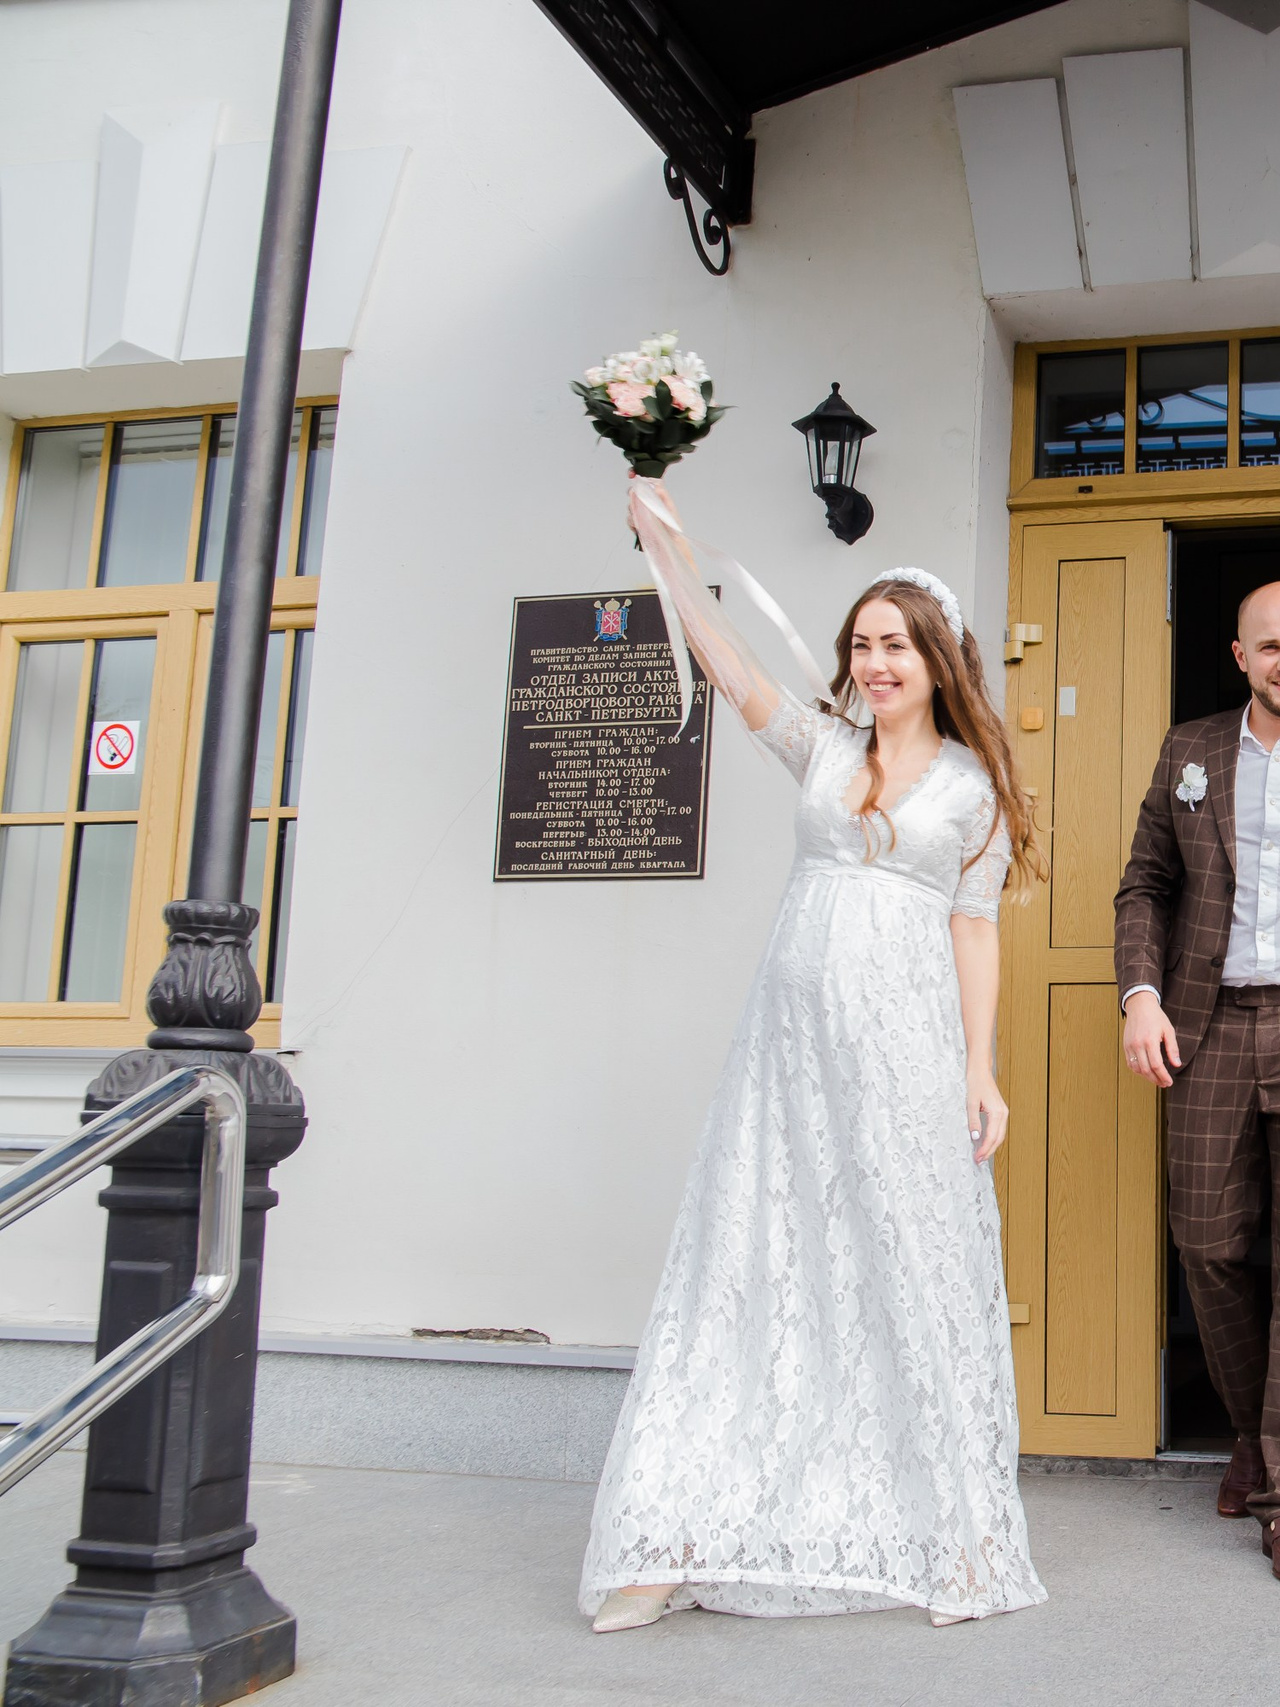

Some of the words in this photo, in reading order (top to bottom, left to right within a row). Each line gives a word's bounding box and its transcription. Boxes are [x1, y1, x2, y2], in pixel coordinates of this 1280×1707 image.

[531, 646, 598, 655] ПРАВИТЕЛЬСТВО
[533, 655, 570, 663] КОМИТЕТ
[588, 653, 619, 661] ДЕЛАМ
[623, 652, 657, 660] ЗАПИСИ
[548, 662, 615, 672] ГРАЖДАНСКОГО
[620, 660, 671, 668] СОСТОЯНИЯ
[531, 674, 576, 687] ОТДЕЛ
[583, 672, 637, 683] ЗАПИСИ
[644, 670, 679, 681] АКТО
[512, 684, 617, 699] ГРАЖДАНСКОГО
[623, 681, 706, 693] СОСТОЯЯ
[512, 697, 644, 711] ПЕТРОДВОРЦОВОГО
[649, 693, 703, 705] РАЙОА
[554, 729, 592, 739] ПРИЕМ
[598, 727, 659, 738] ГРАЖДАН:
[551, 749, 589, 757] СУББОТА
[556, 759, 591, 769] ПРИЕМ
[596, 758, 651, 768] ГРАЖДАН
[538, 770, 618, 780] НАЧАЛЬНИКОМ
[623, 768, 671, 779] ОТДЕЛА:
[548, 781, 587, 789] ВТОРНИК
[536, 800, 613, 811] РЕГИСТРАЦИЯ
[619, 798, 668, 808] СМЕРТИ:
[546, 820, 585, 828] СУББОТА
[515, 840, 576, 849] ВОСКРЕСЕНЬЕ
[588, 835, 649, 847] ВЫХОДНОЙ
[652, 837, 682, 847] ДЕНЬ
[541, 849, 615, 861] САНИТАРНЫЙ
[623, 850, 657, 860] ДЕНЬ:
[511, 862, 563, 871] ПОСЛЕДНИЙ
[568, 861, 607, 870] РАБОЧИЙ
[611, 862, 634, 870] ДЕНЬ
[640, 861, 685, 869] КВАРТАЛА
